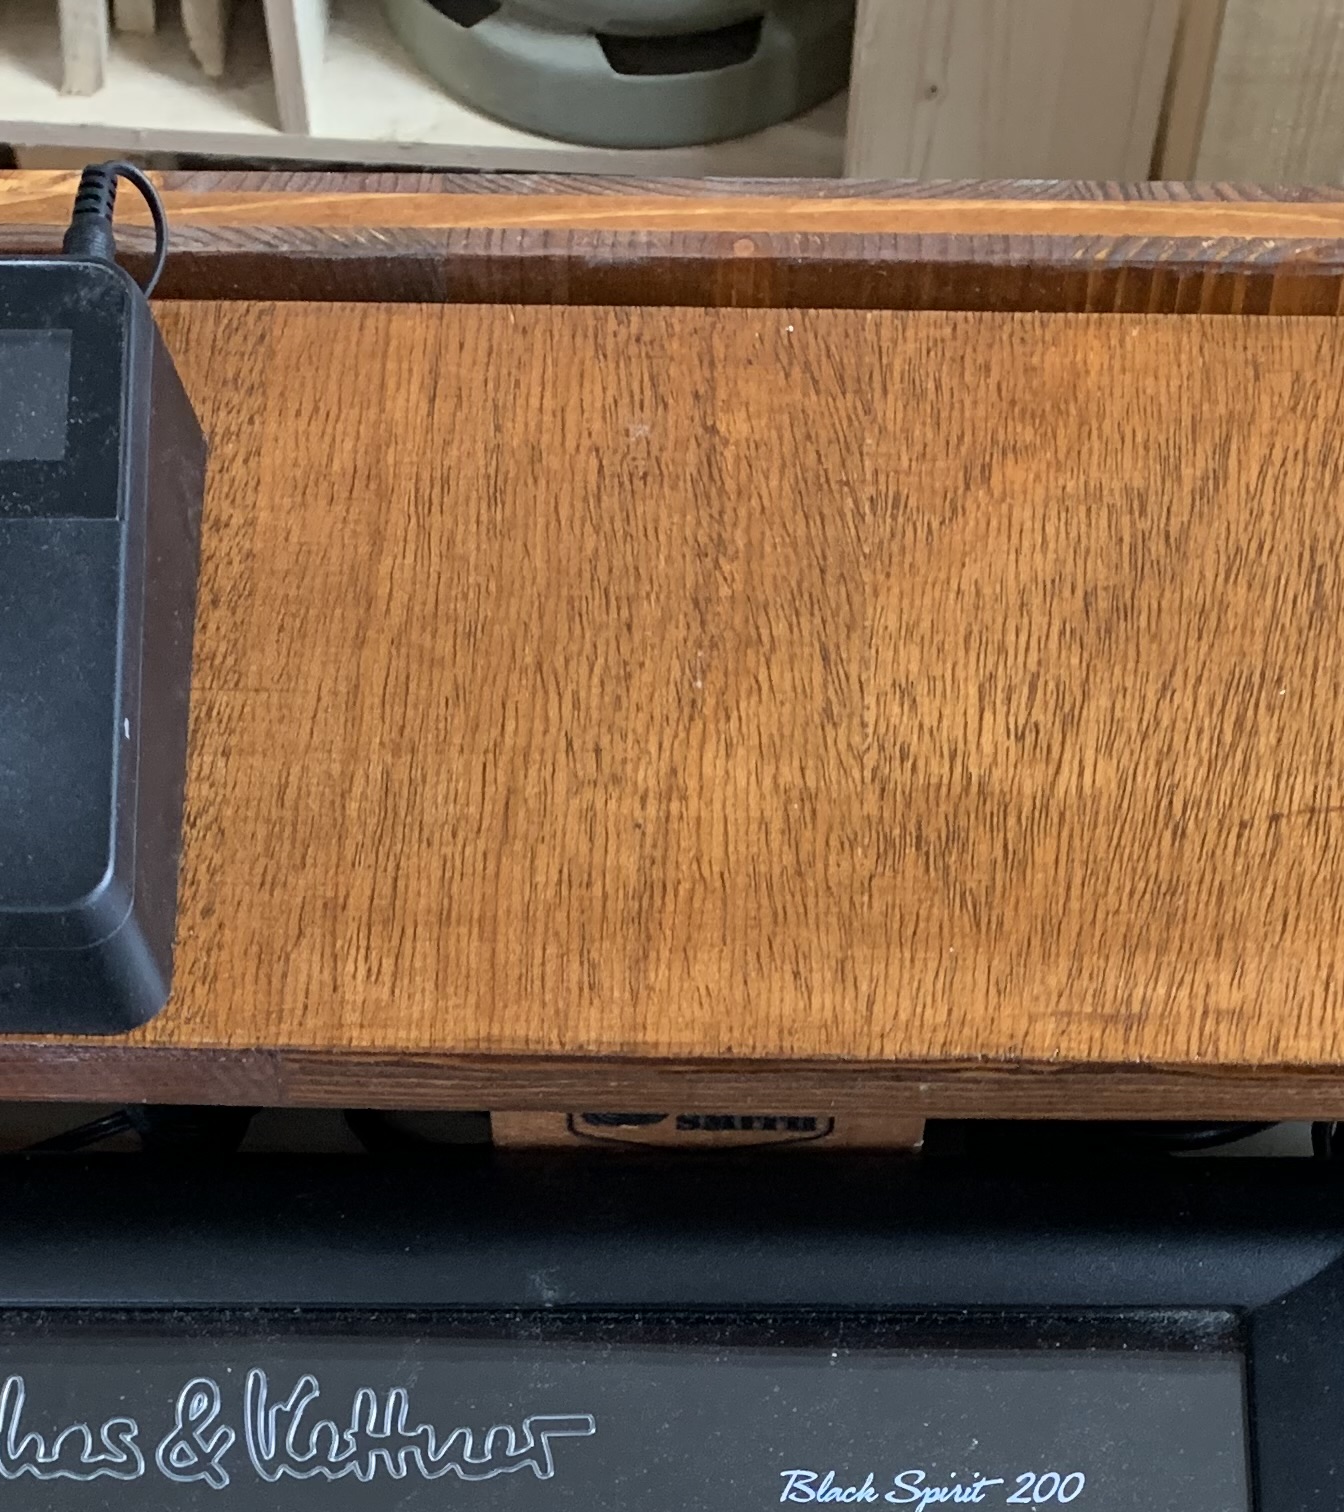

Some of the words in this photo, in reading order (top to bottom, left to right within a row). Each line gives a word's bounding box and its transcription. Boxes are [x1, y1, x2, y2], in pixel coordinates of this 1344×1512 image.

[157, 1376, 237, 1490] &
[779, 1468, 880, 1504] Black
[1005, 1470, 1087, 1505] 200
